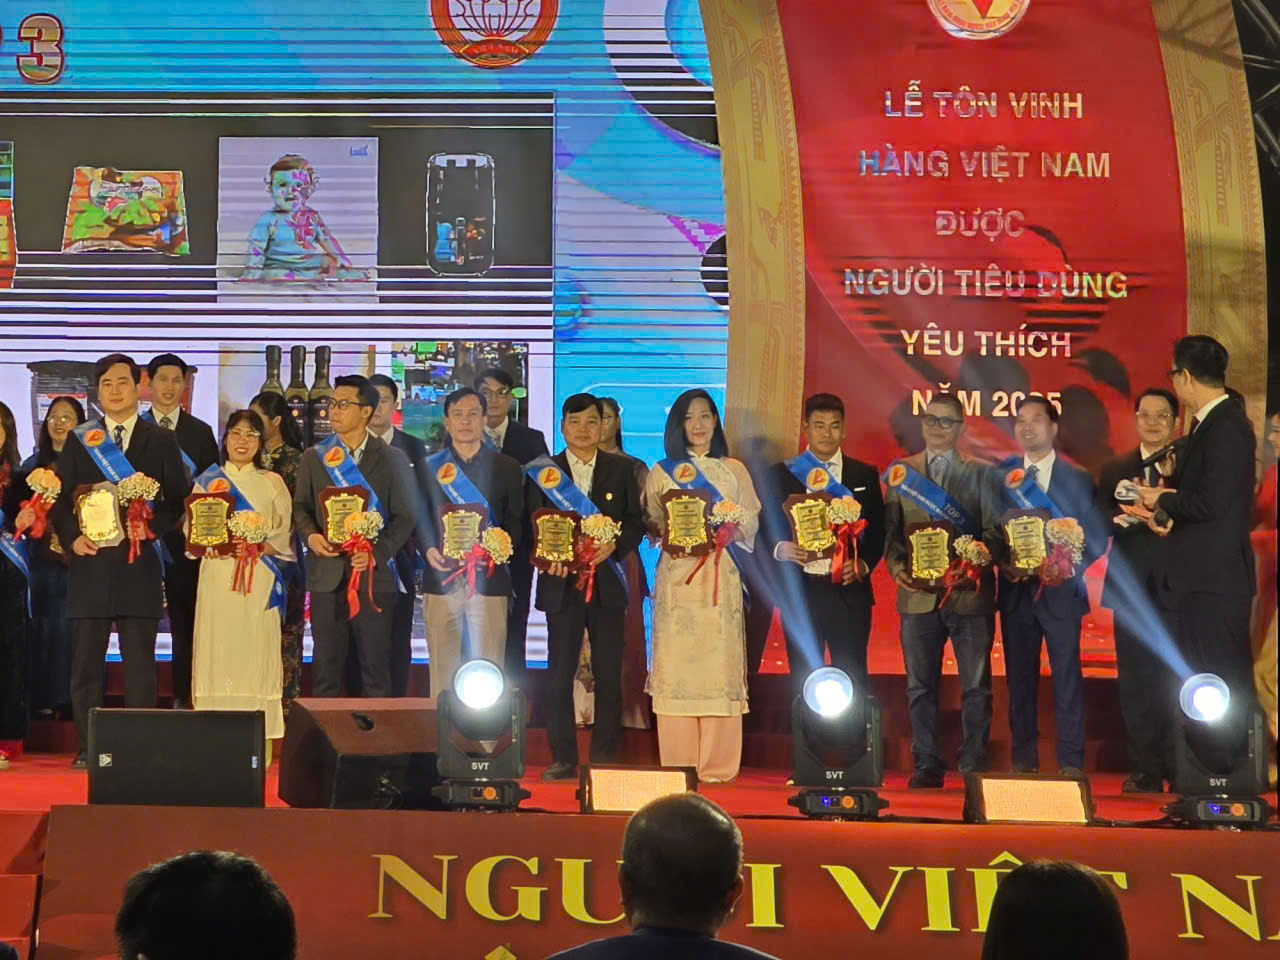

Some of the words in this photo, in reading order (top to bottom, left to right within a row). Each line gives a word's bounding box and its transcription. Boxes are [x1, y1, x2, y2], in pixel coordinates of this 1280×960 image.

[17, 13, 65, 85] 3
[884, 80, 922, 118] LỄ
[933, 85, 997, 118] TÔN
[1008, 92, 1083, 118] VINH
[859, 143, 948, 177] HÀNG
[960, 145, 1030, 183] VIỆT
[1040, 152, 1110, 177] NAM
[935, 208, 1025, 242] ĐƯỢC
[844, 264, 944, 296] NGƯỜI
[954, 264, 1025, 297] TIÊU
[1037, 265, 1128, 298] DÙNG
[901, 323, 964, 356] YÊU
[974, 323, 1071, 357] THÍCH
[912, 382, 981, 417] NM
[992, 389, 1062, 417] 205
[471, 762, 490, 770] SVT
[825, 771, 844, 779] SVT
[1209, 778, 1227, 786] SVT
[368, 854, 785, 928] NGUI
